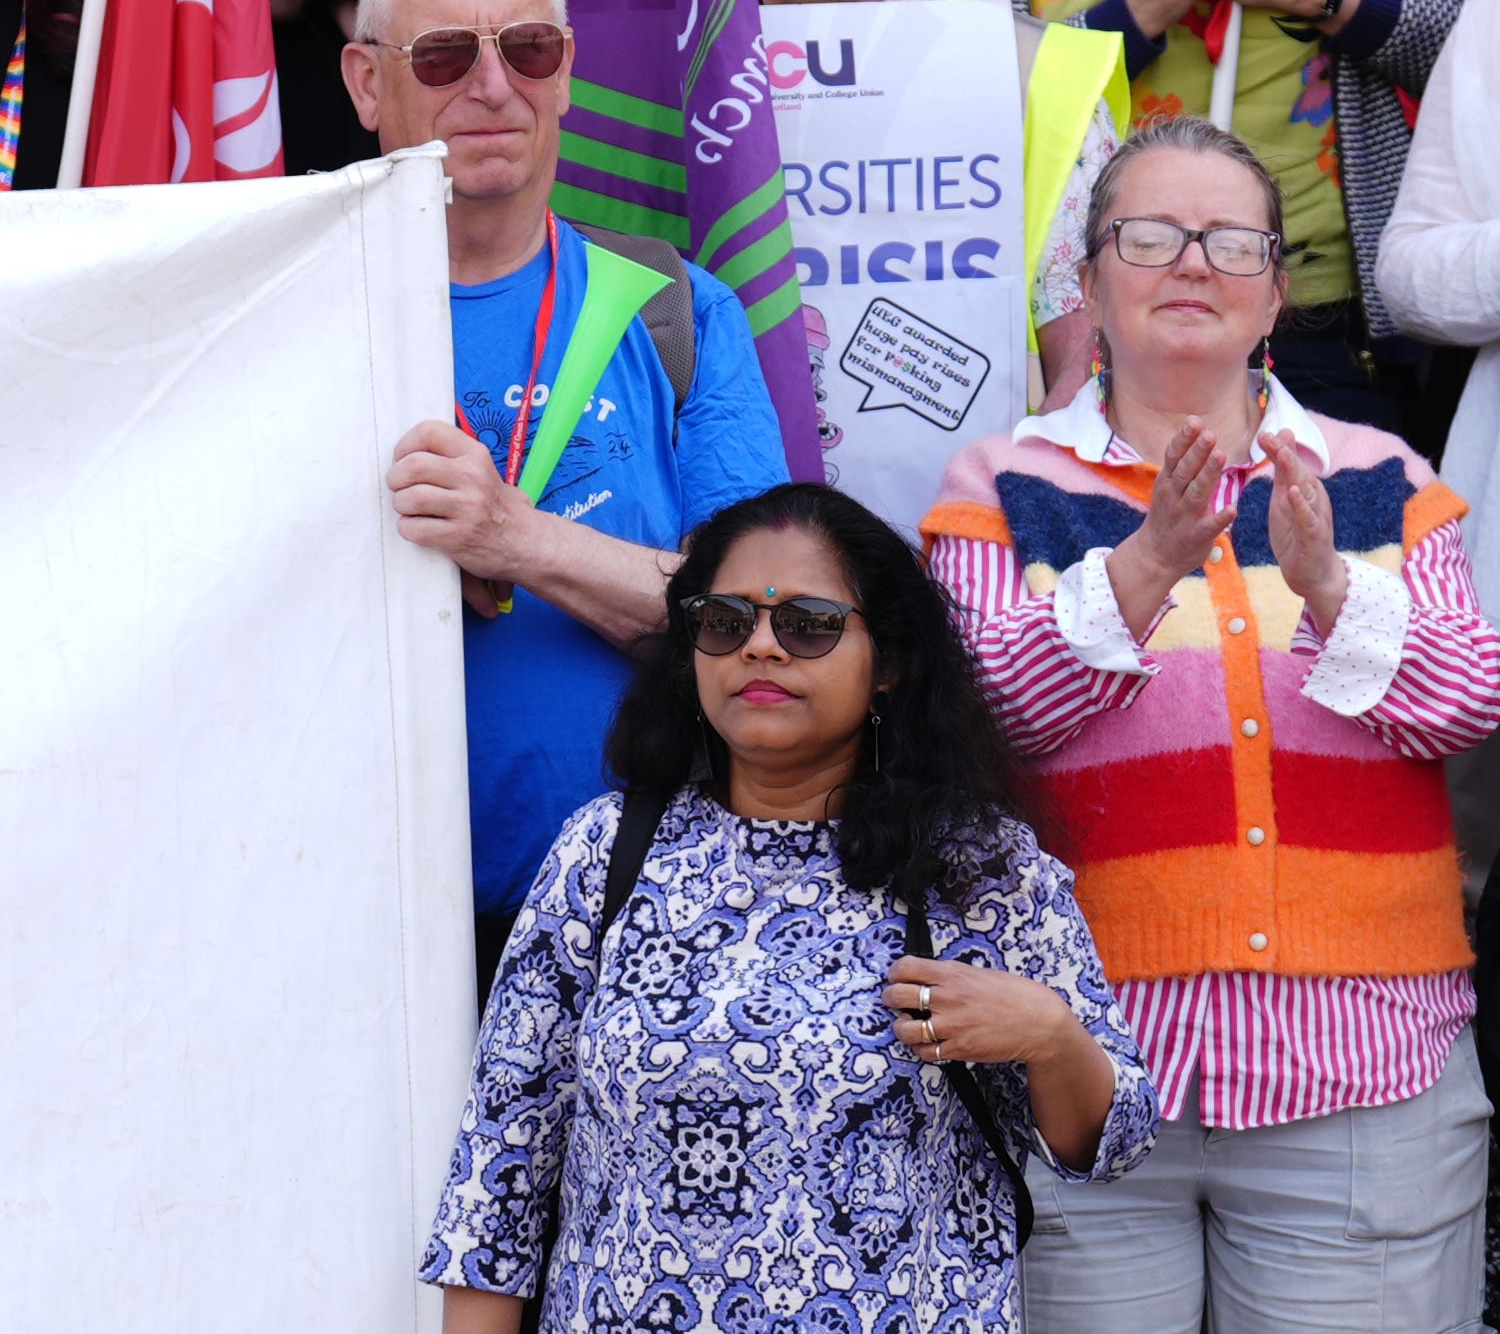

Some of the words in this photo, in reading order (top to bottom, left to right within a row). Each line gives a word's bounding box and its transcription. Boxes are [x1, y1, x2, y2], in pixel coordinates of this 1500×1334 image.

[856, 335, 881, 355] for
[864, 319, 898, 346] huge
[900, 343, 929, 365] pay
[932, 361, 971, 388] rises
[903, 325, 969, 366] awarded
[504, 384, 616, 422] COST
[848, 352, 960, 421] mismanagment
